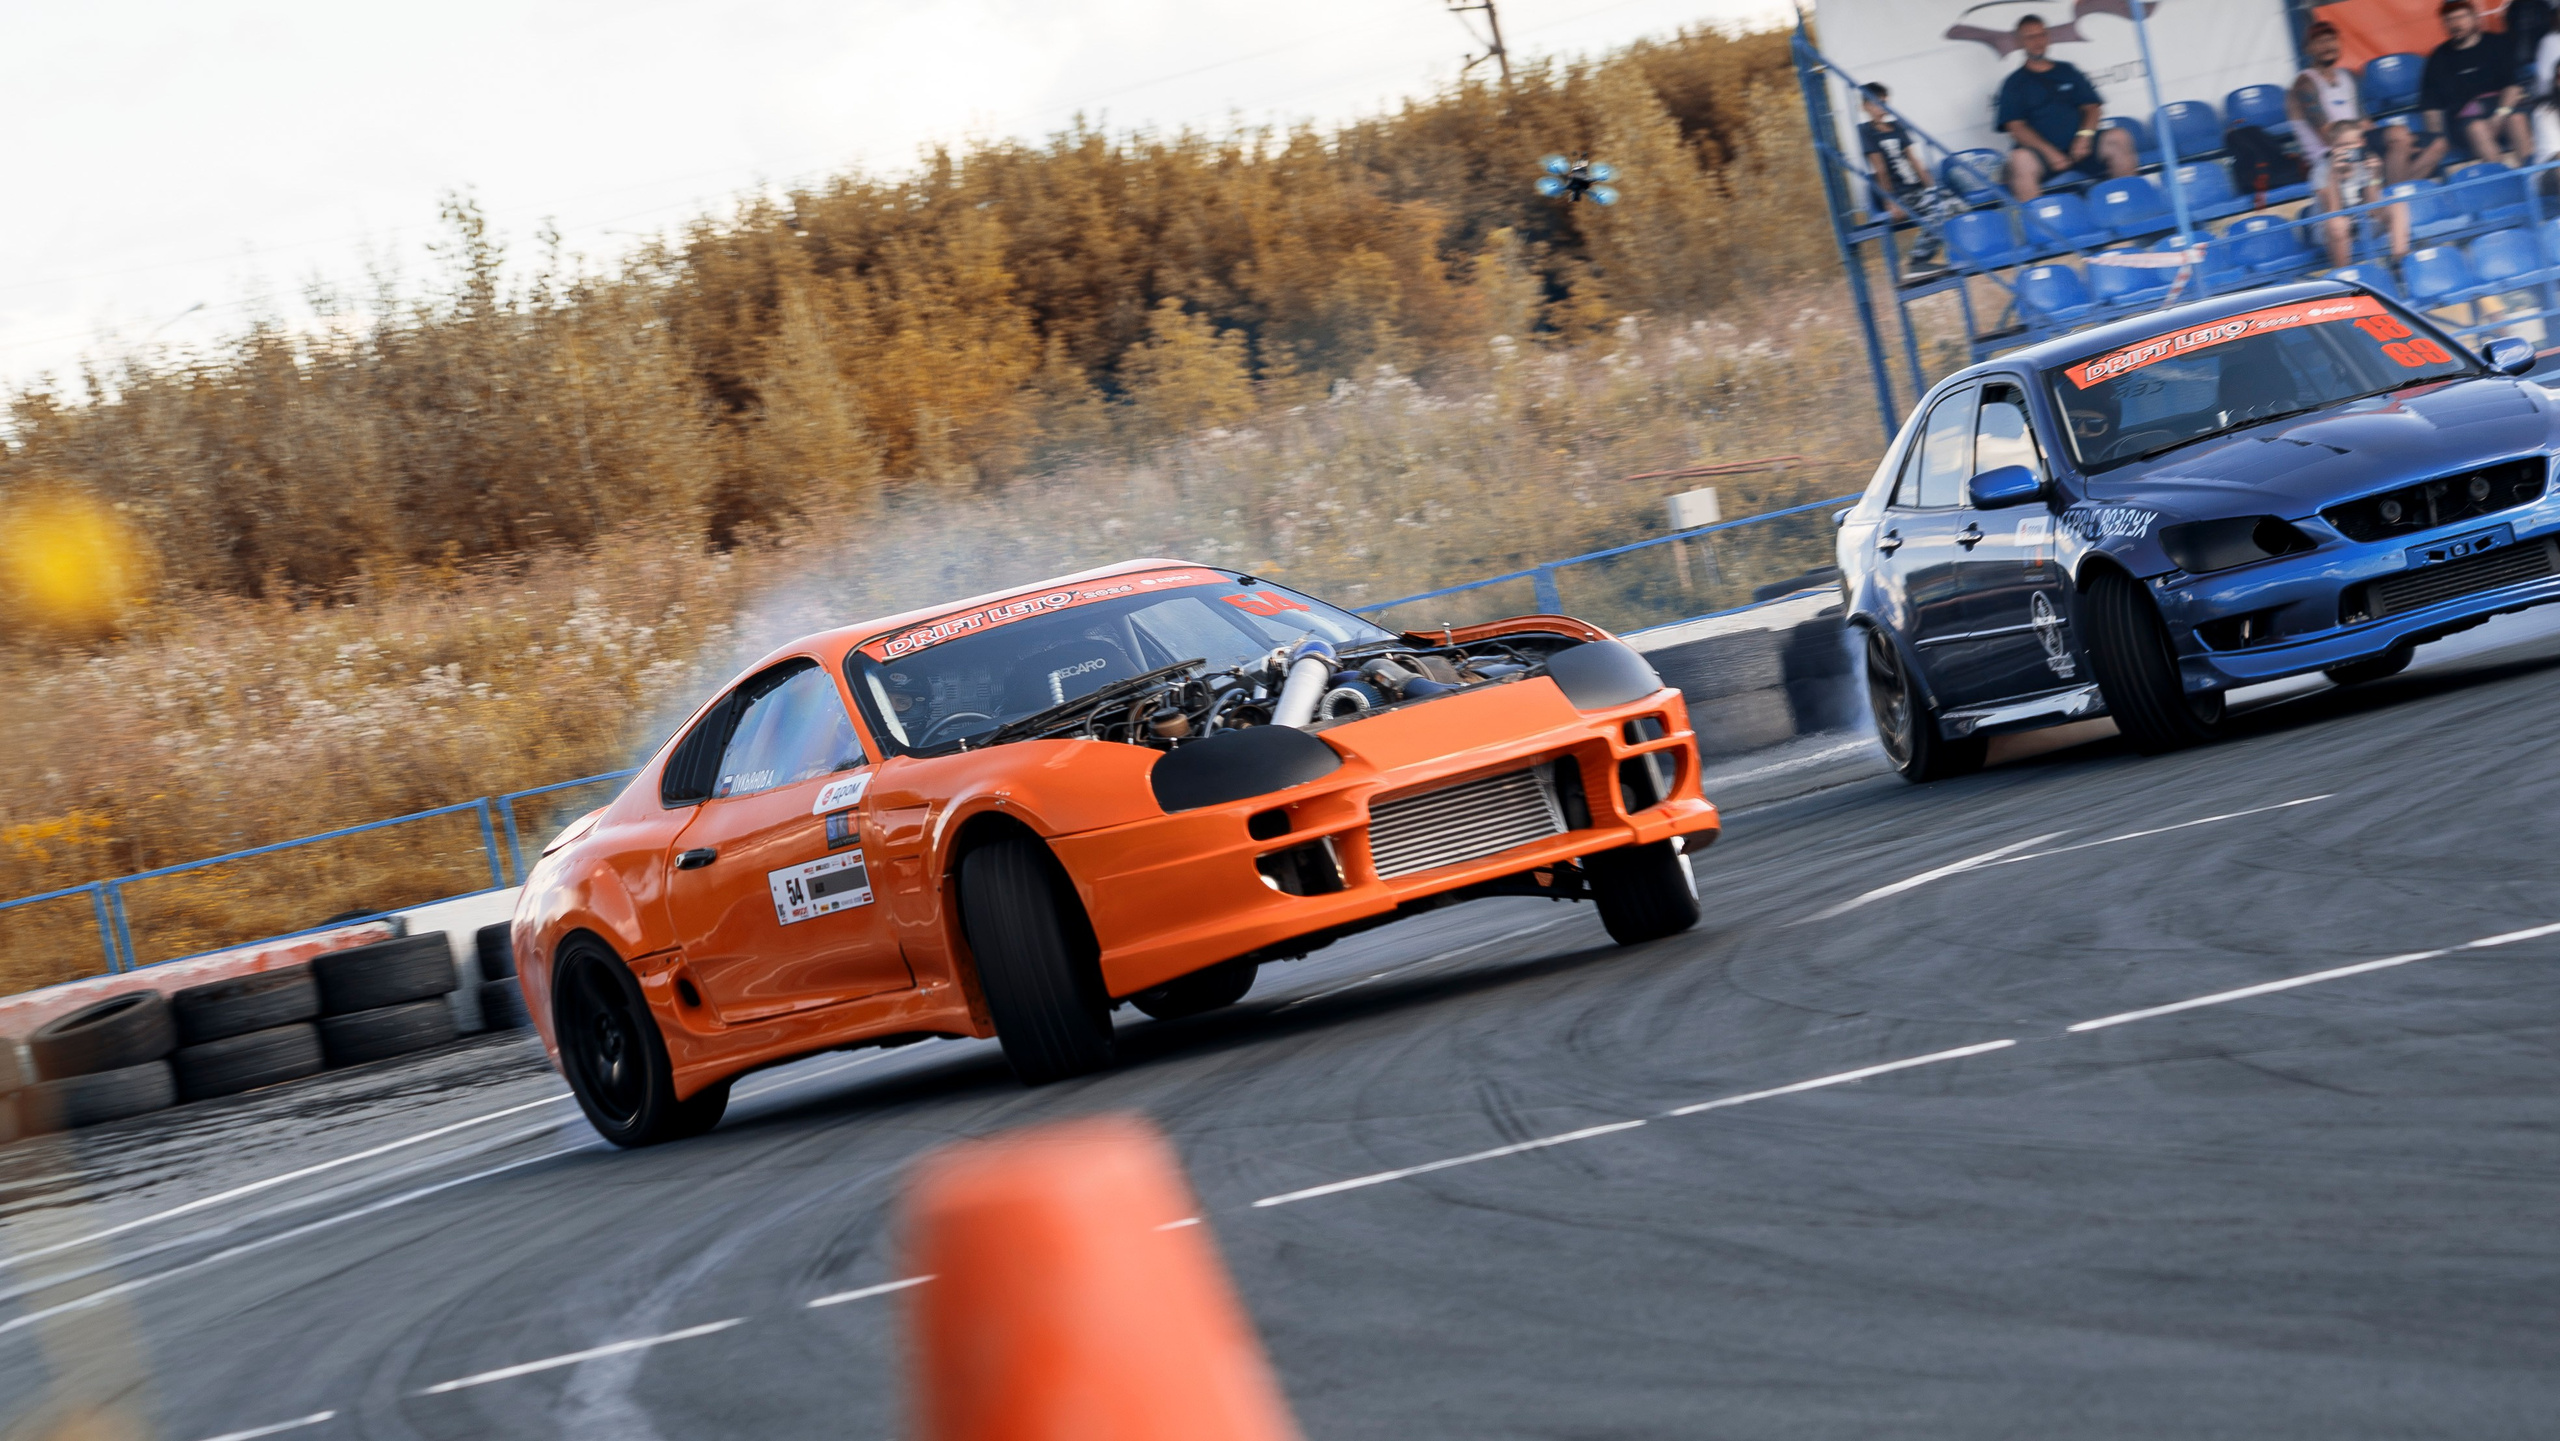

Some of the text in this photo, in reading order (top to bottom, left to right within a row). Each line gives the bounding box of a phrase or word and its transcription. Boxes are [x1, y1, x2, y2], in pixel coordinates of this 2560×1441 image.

[2353, 314, 2413, 343] 18
[2085, 338, 2172, 382] DRIFT
[2173, 320, 2249, 350] LETO
[2381, 338, 2453, 368] 69
[1219, 590, 1311, 616] 54
[885, 612, 984, 657] DRIFT
[987, 591, 1074, 624] LETO
[786, 877, 805, 906] 54
